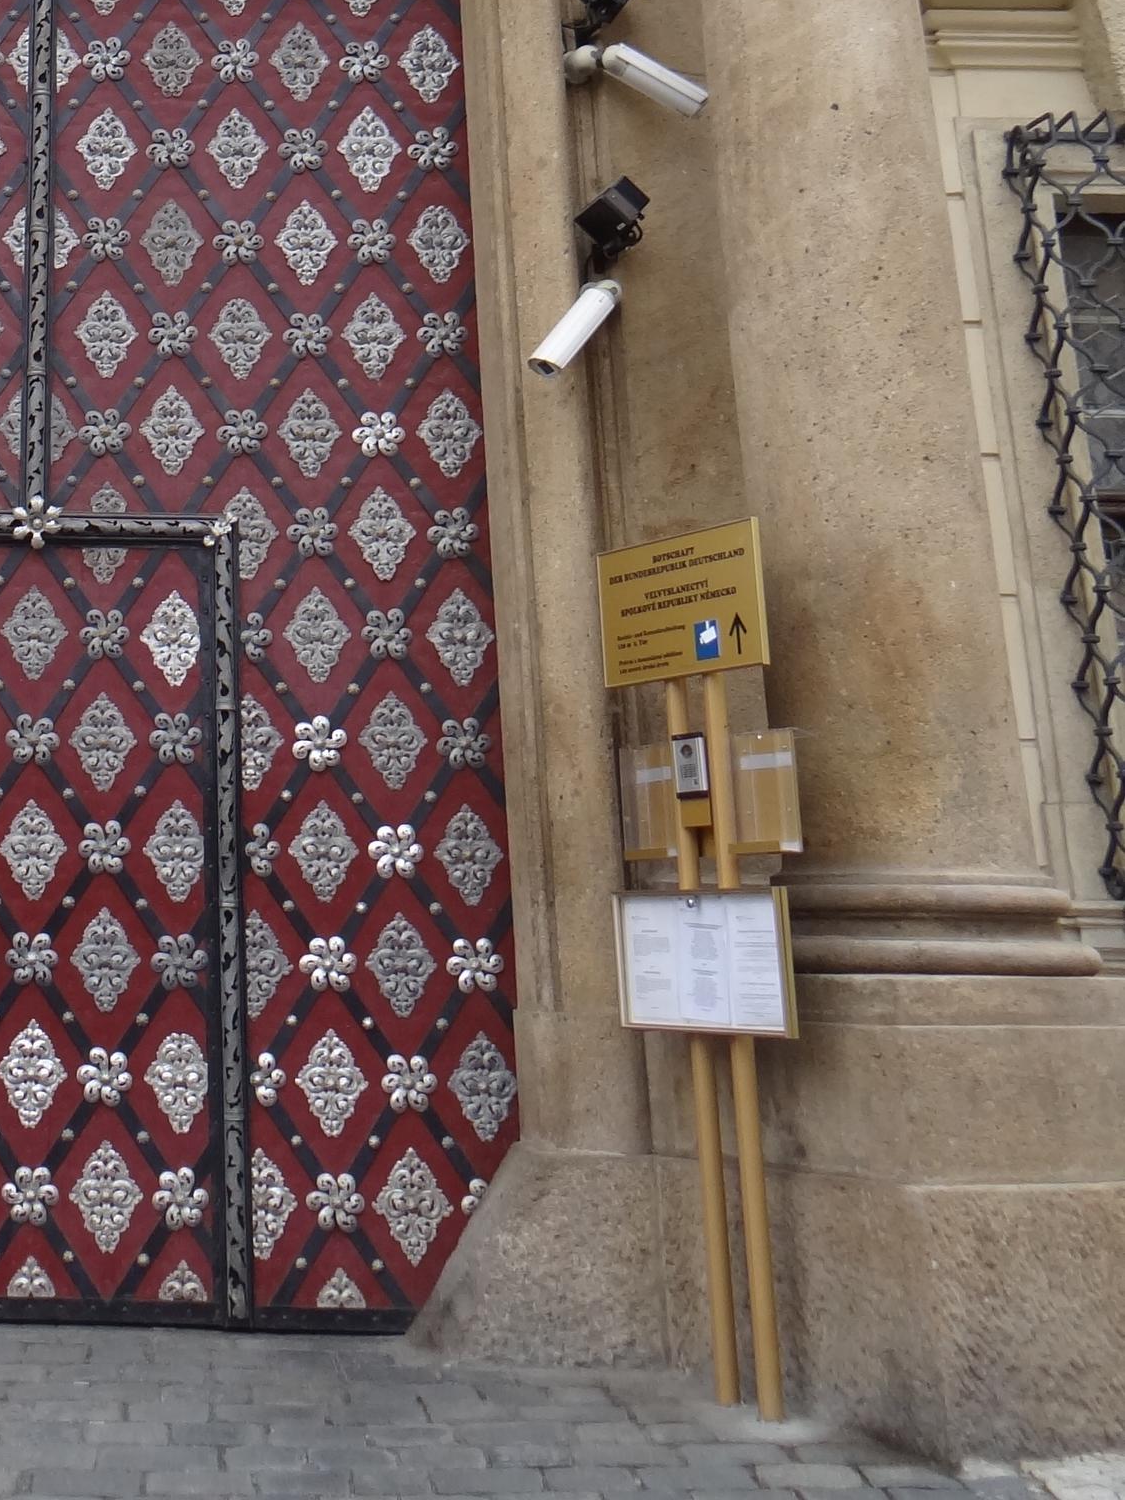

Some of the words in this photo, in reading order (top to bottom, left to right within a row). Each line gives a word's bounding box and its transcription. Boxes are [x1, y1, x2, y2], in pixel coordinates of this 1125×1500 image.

[652, 547, 695, 564] BOTSCHAFT
[609, 576, 623, 586] DER
[624, 561, 687, 582] BUNDESREPUBLIK
[688, 548, 745, 567] DEUTSCHLAND
[657, 594, 698, 610] REPUBLIKY
